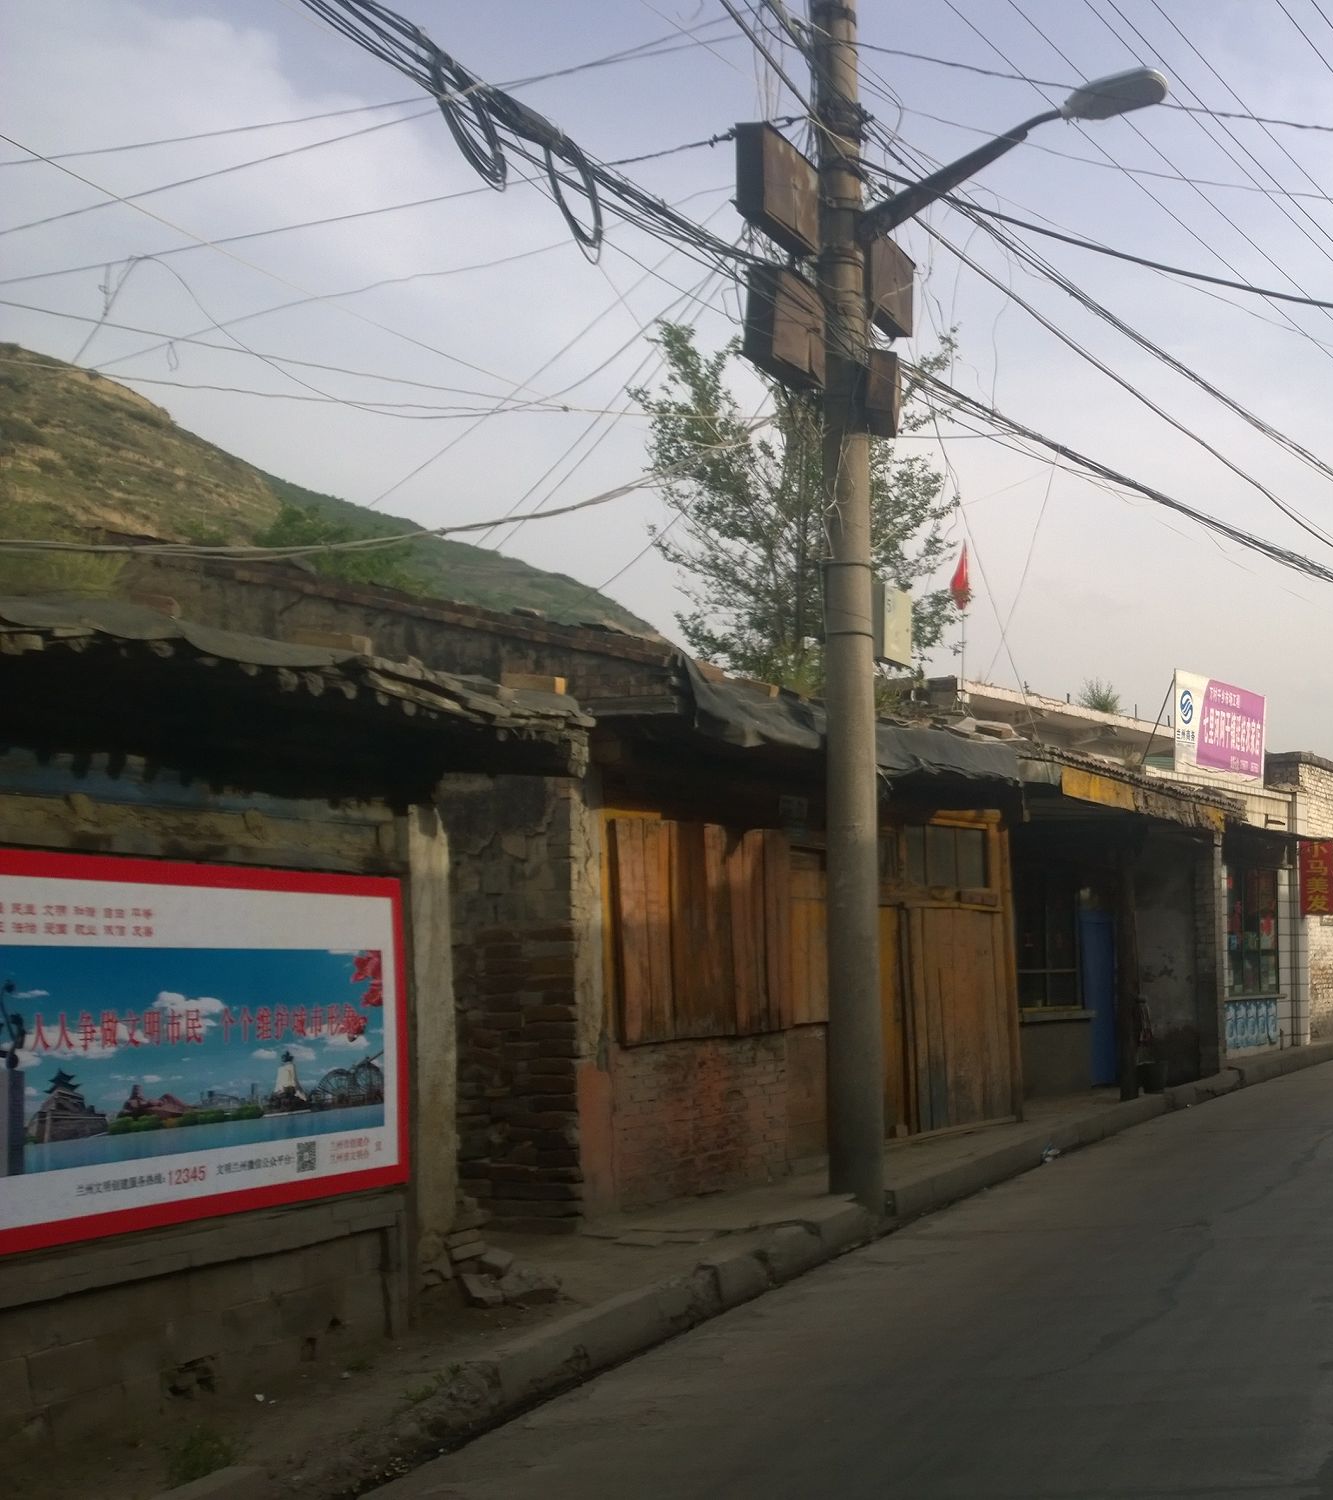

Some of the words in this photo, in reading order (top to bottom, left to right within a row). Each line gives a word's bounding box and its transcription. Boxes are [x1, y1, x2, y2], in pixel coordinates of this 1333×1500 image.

[1306, 841, 1329, 912] 小马美发
[31, 1009, 203, 1051] 人人争做文明市民
[168, 1165, 208, 1186] 12345
